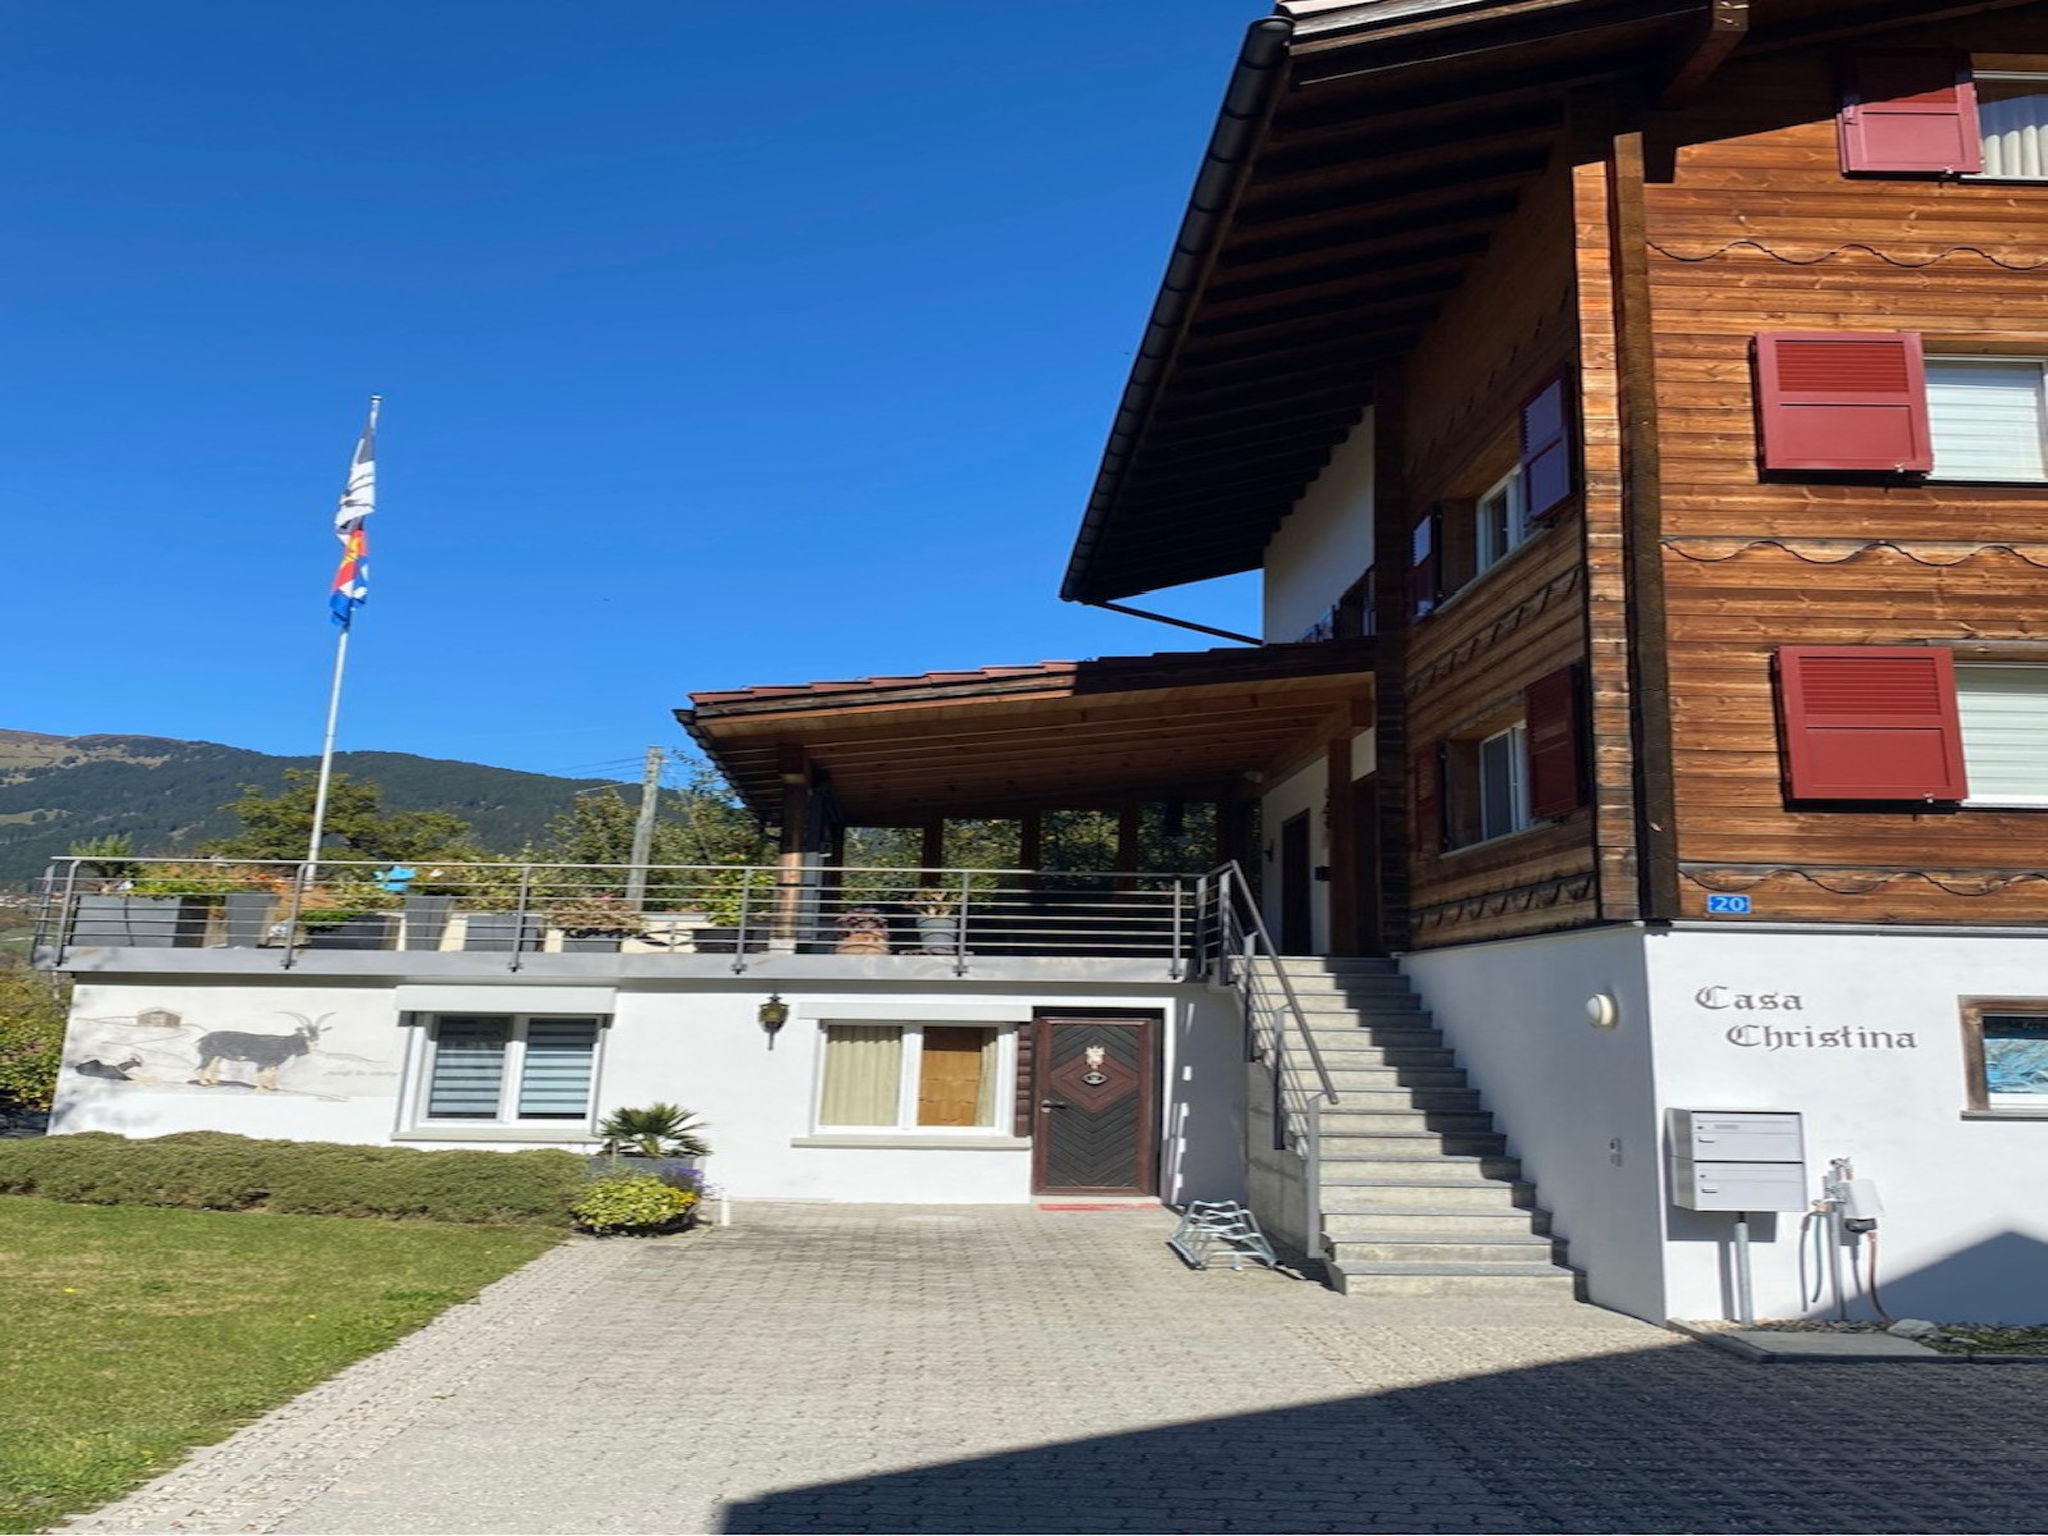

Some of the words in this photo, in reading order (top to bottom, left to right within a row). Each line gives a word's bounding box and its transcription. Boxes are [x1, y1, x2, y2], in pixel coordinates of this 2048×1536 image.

[1713, 896, 1746, 912] 20
[1695, 985, 1803, 1011] Casa
[1726, 1024, 1918, 1052] Christina
